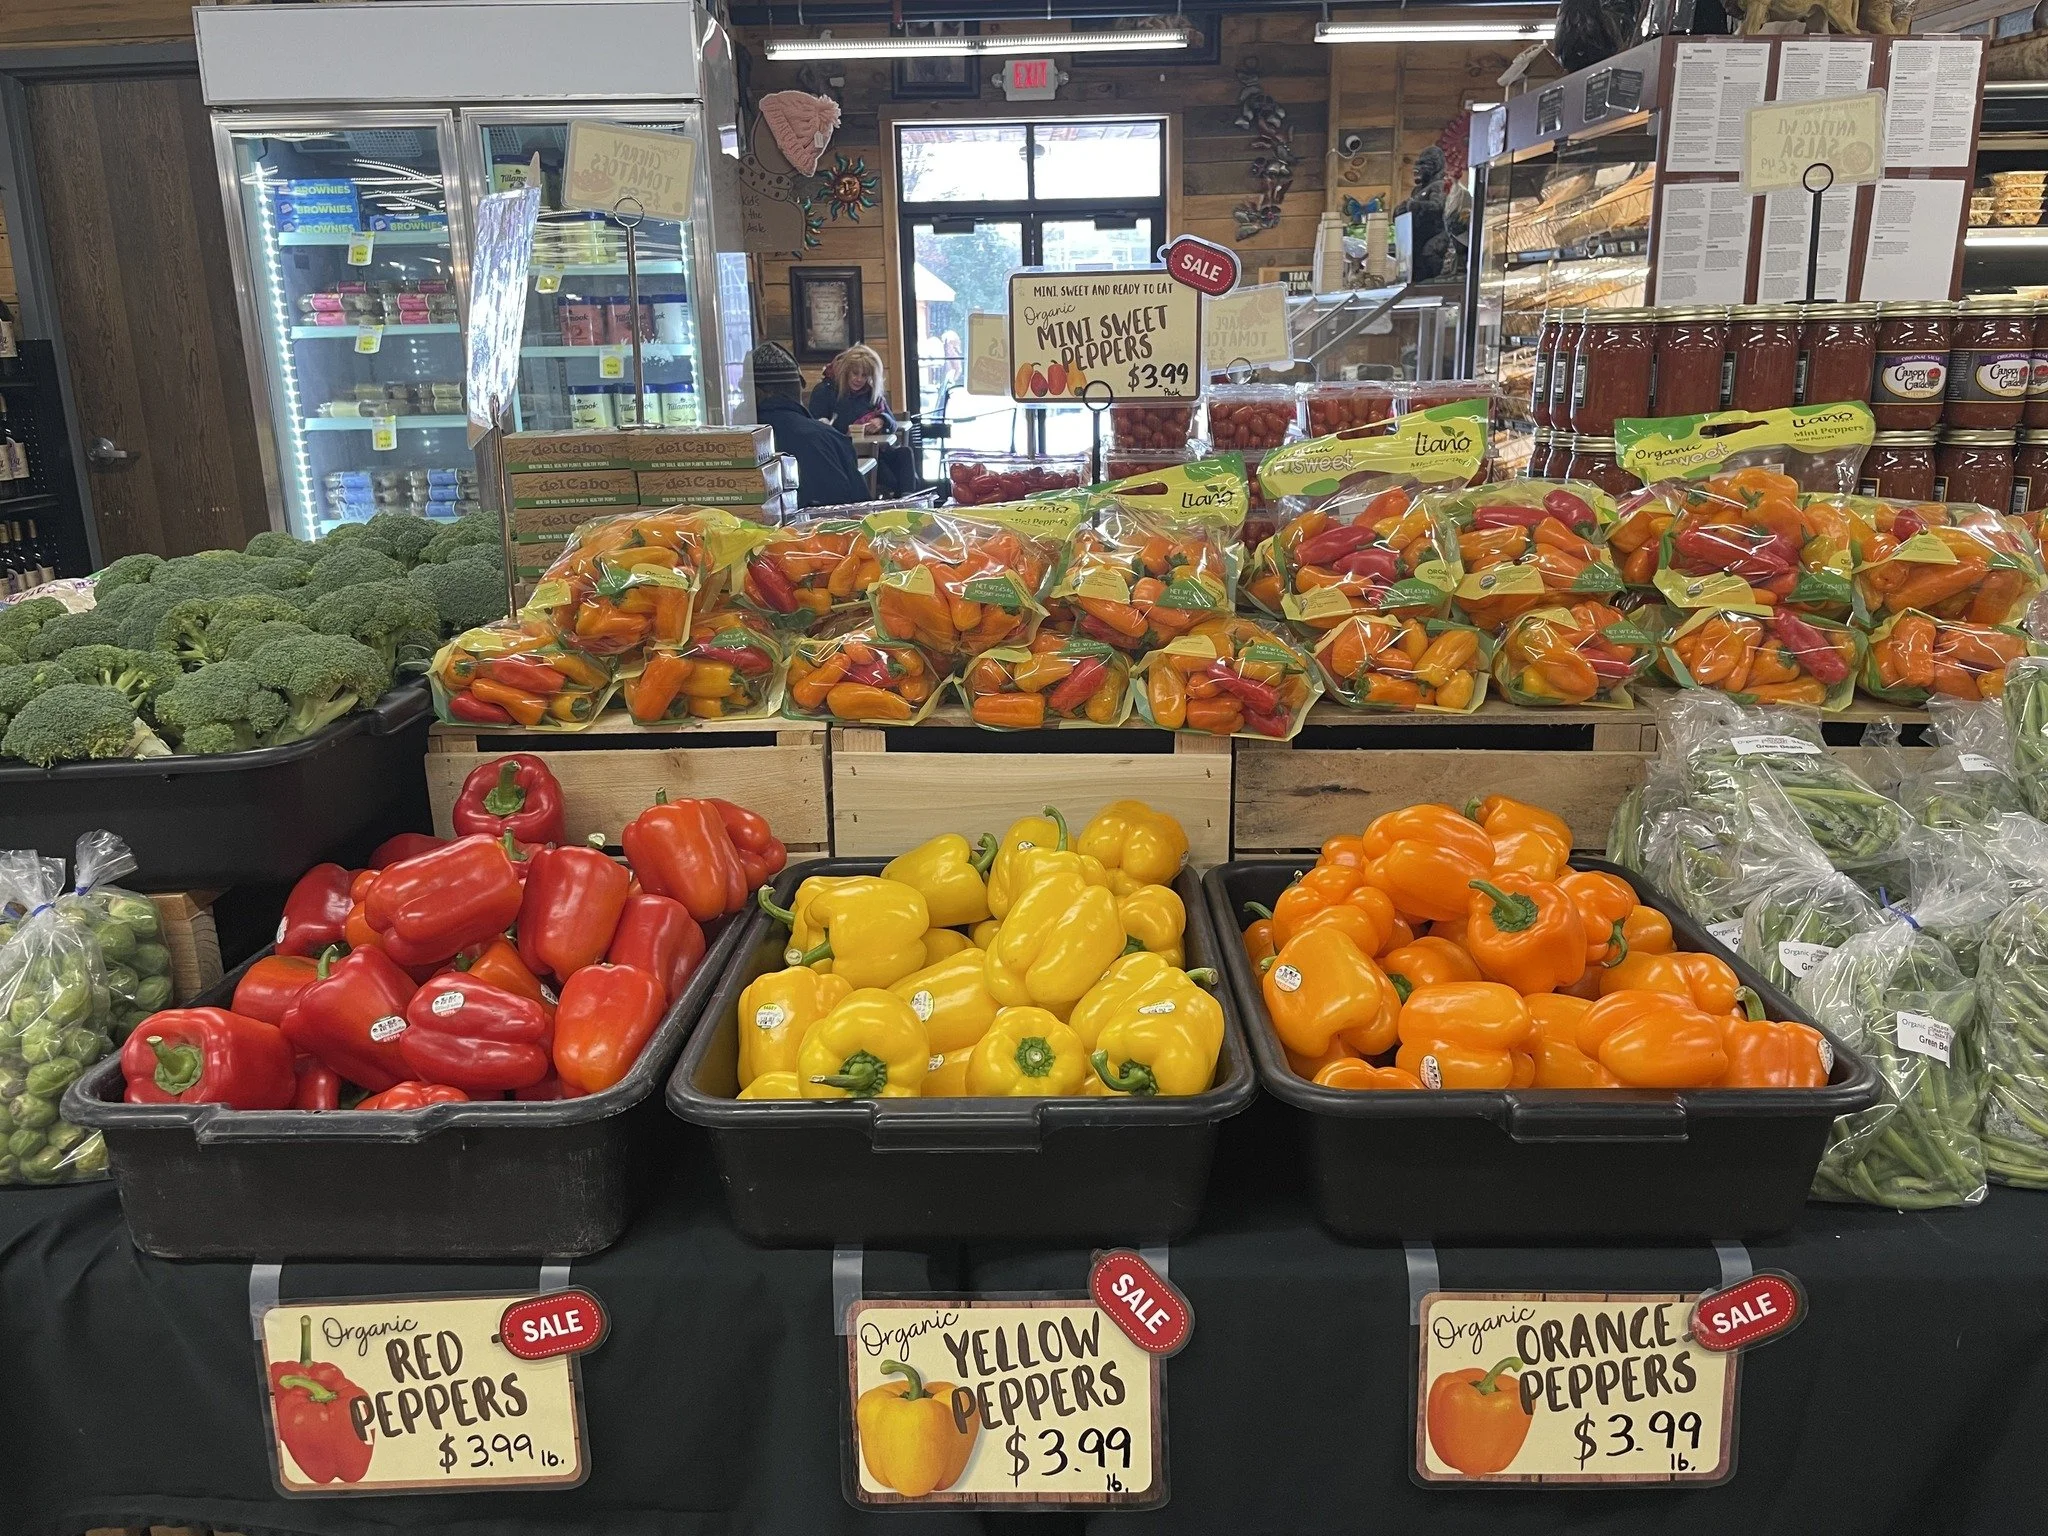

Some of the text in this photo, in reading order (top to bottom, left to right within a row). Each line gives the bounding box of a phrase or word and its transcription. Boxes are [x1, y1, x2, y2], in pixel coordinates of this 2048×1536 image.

[1013, 61, 1047, 88] EXIT
[296, 185, 350, 195] BROWNIES
[500, 174, 527, 184] Tillamo
[297, 204, 353, 214] BROWNIES
[299, 224, 355, 232] BROWNIES
[1180, 253, 1223, 283] SALE
[1288, 272, 1310, 281] TRAY
[1060, 284, 1088, 297] SWEET
[1092, 284, 1111, 296] AND
[1112, 283, 1140, 296] READY
[1143, 283, 1155, 295] TO
[1157, 282, 1174, 295] EAT
[1023, 302, 1076, 329] Organic
[1037, 316, 1093, 350] MINI
[1100, 304, 1168, 340] SWEET
[1061, 333, 1153, 372] PEPPERS
[1127, 362, 1189, 393] $3.99
[1895, 366, 1927, 382] Canopy
[1989, 364, 2019, 380] Canopy
[667, 402, 697, 411] Tillamoo
[1791, 411, 1853, 428] Llano
[1414, 431, 1472, 457] Llano
[1793, 423, 1865, 439] Mini Peppers
[1635, 442, 1702, 460] Organic
[1181, 491, 1235, 509] Llano
[1712, 928, 1736, 937] Organic
[1783, 948, 1810, 956] Organic
[1902, 1018, 1926, 1030] Organic
[1919, 1035, 1938, 1049] Green
[1110, 1272, 1171, 1336] SALE
[1711, 1291, 1777, 1335] SALE
[321, 1315, 418, 1357] Organic
[521, 1309, 584, 1343] SALE
[860, 1310, 959, 1362] Organic
[1432, 1305, 1536, 1355] Organic
[1516, 1302, 1677, 1366] ORANGE
[385, 1330, 463, 1384] RED
[943, 1311, 1100, 1378] YELLOW
[1518, 1350, 1697, 1416] PEPPERS
[349, 1372, 529, 1442] PEPPERS
[951, 1360, 1126, 1434] PEPPERS
[438, 1433, 565, 1474] $3.99 lb.
[1573, 1410, 1702, 1471] $3.99
[1005, 1425, 1132, 1488] $3.99
[1670, 1452, 1696, 1472] lb.
